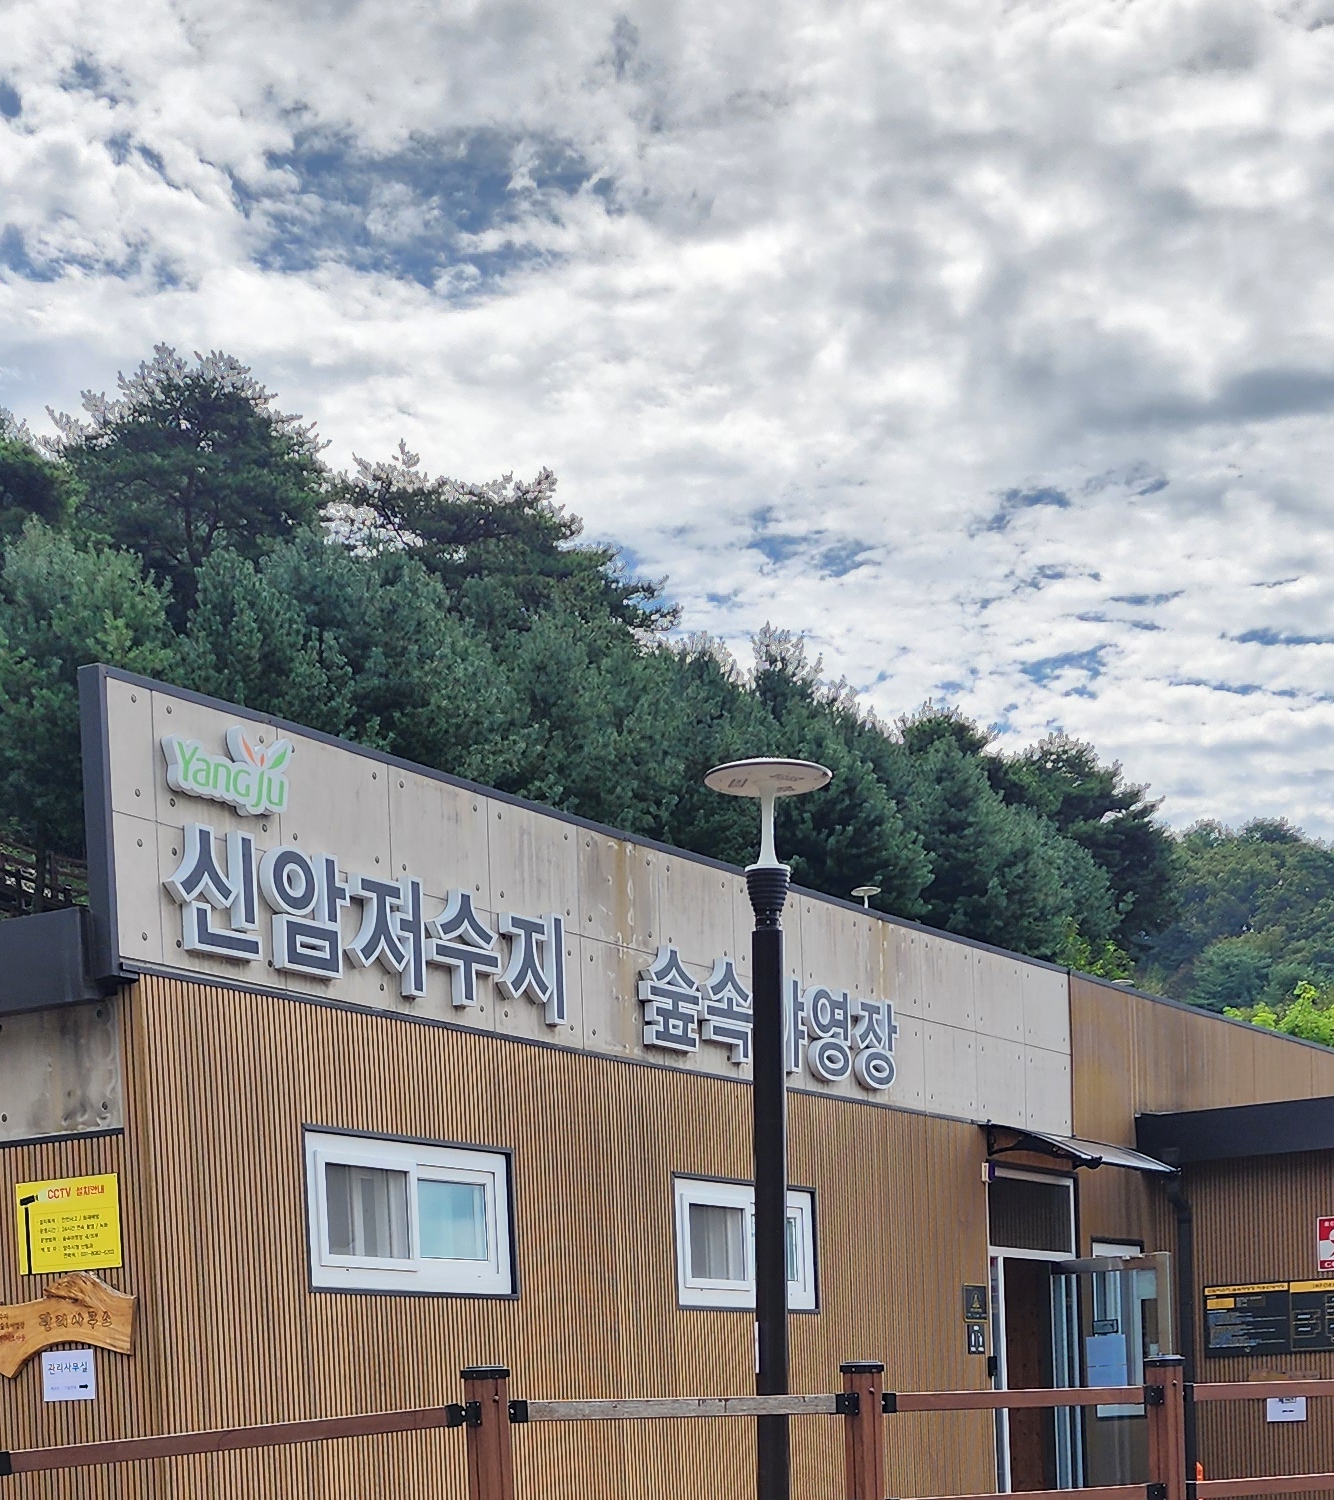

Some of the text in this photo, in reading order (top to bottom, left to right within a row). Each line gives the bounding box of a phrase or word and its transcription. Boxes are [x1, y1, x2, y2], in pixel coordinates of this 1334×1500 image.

[163, 823, 567, 1027] 신암저수지
[47, 1184, 105, 1200] CCTV 설치안내
[47, 1361, 88, 1375] 관리사무실
